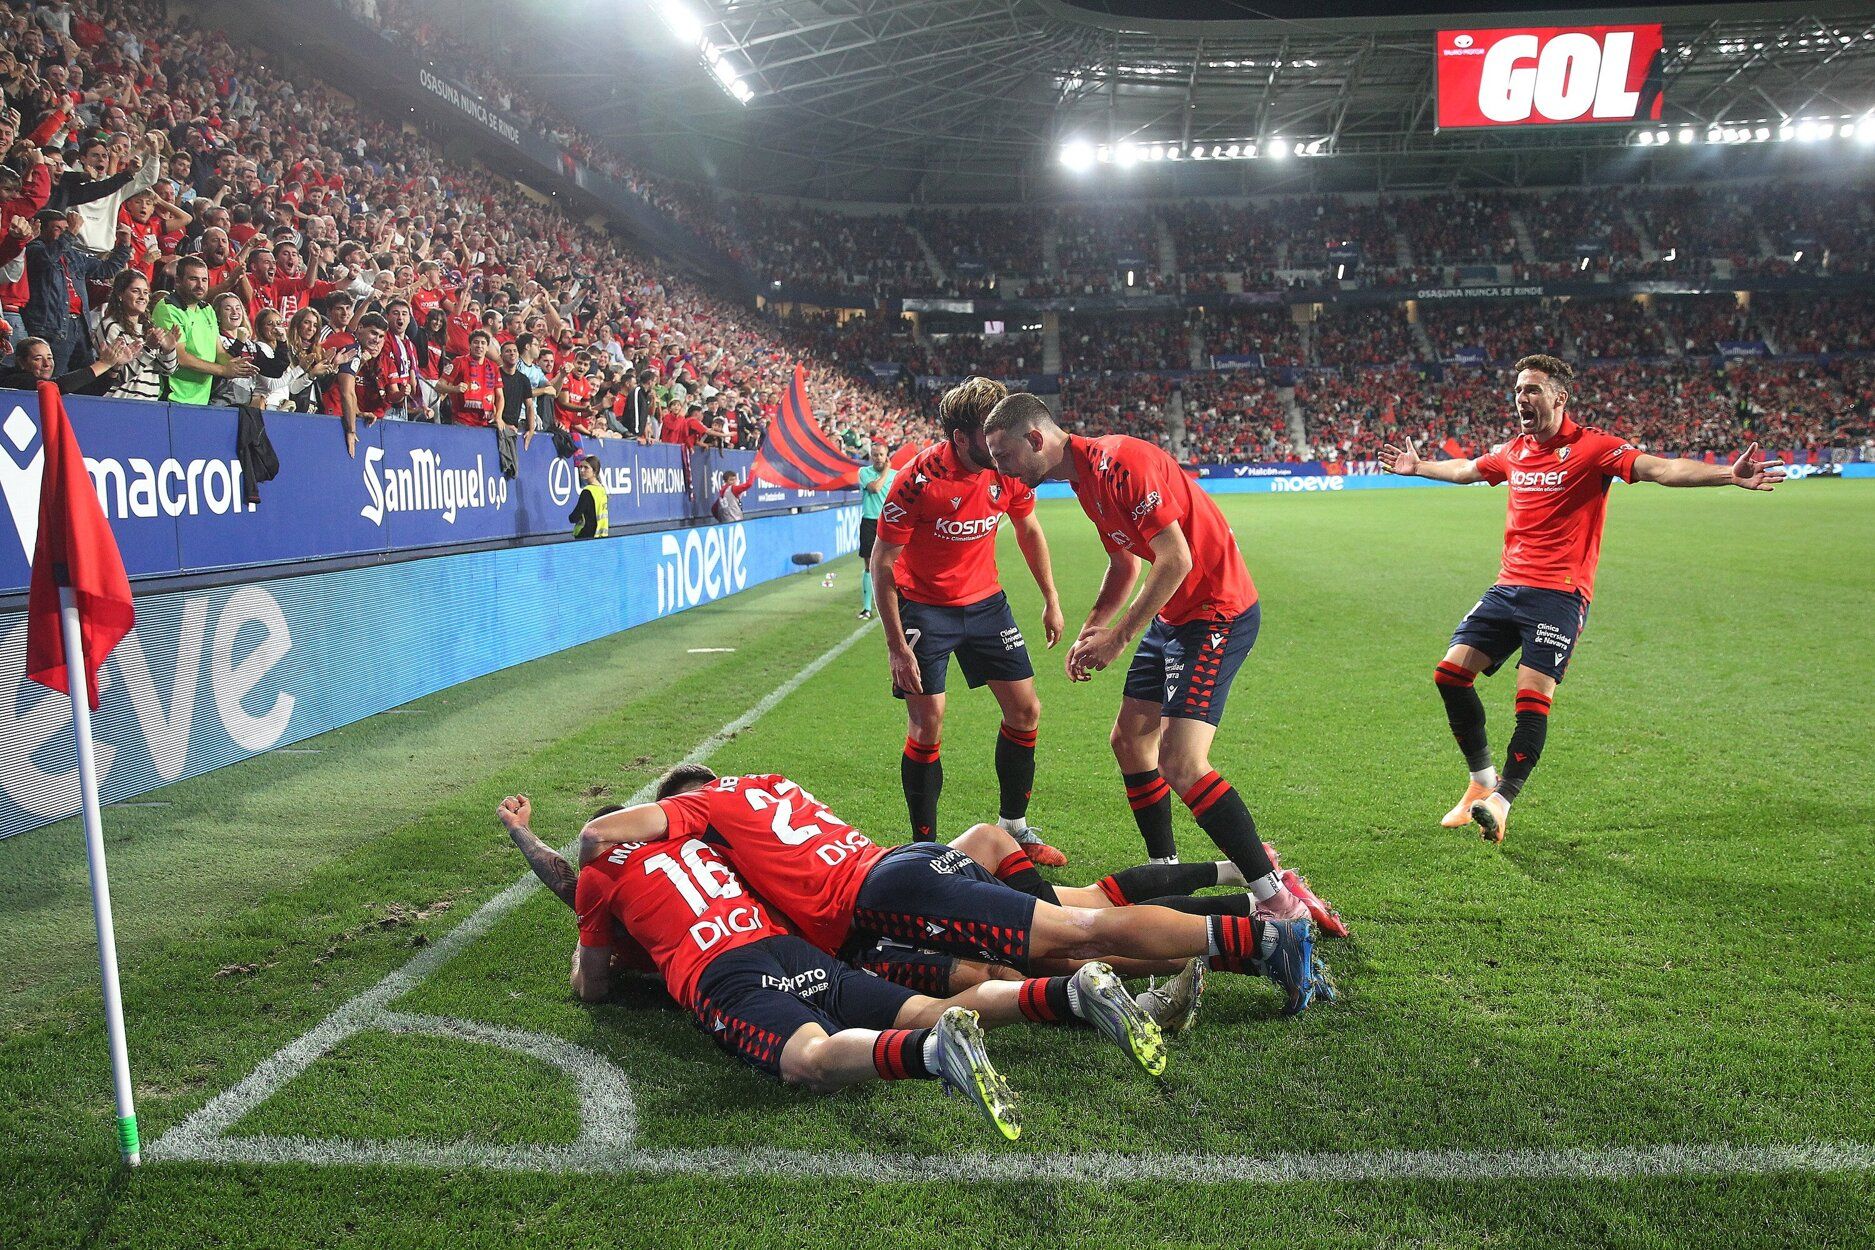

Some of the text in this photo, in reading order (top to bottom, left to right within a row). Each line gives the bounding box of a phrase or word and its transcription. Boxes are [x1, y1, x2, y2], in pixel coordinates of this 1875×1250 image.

[1478, 32, 1640, 122] GOL
[420, 69, 519, 144] OSASUNA NUNCA SE RINDE
[1417, 286, 1543, 299] OSASUNA NUNCA SE RINDE
[574, 467, 631, 495] LXUS
[1271, 476, 1344, 491] moeve
[657, 523, 747, 616] moeve
[1534, 635, 1568, 650] de Navarra
[1536, 629, 1571, 645] Universidad
[744, 777, 848, 845] 23
[643, 838, 743, 918] 16
[689, 906, 764, 951] DIGI
